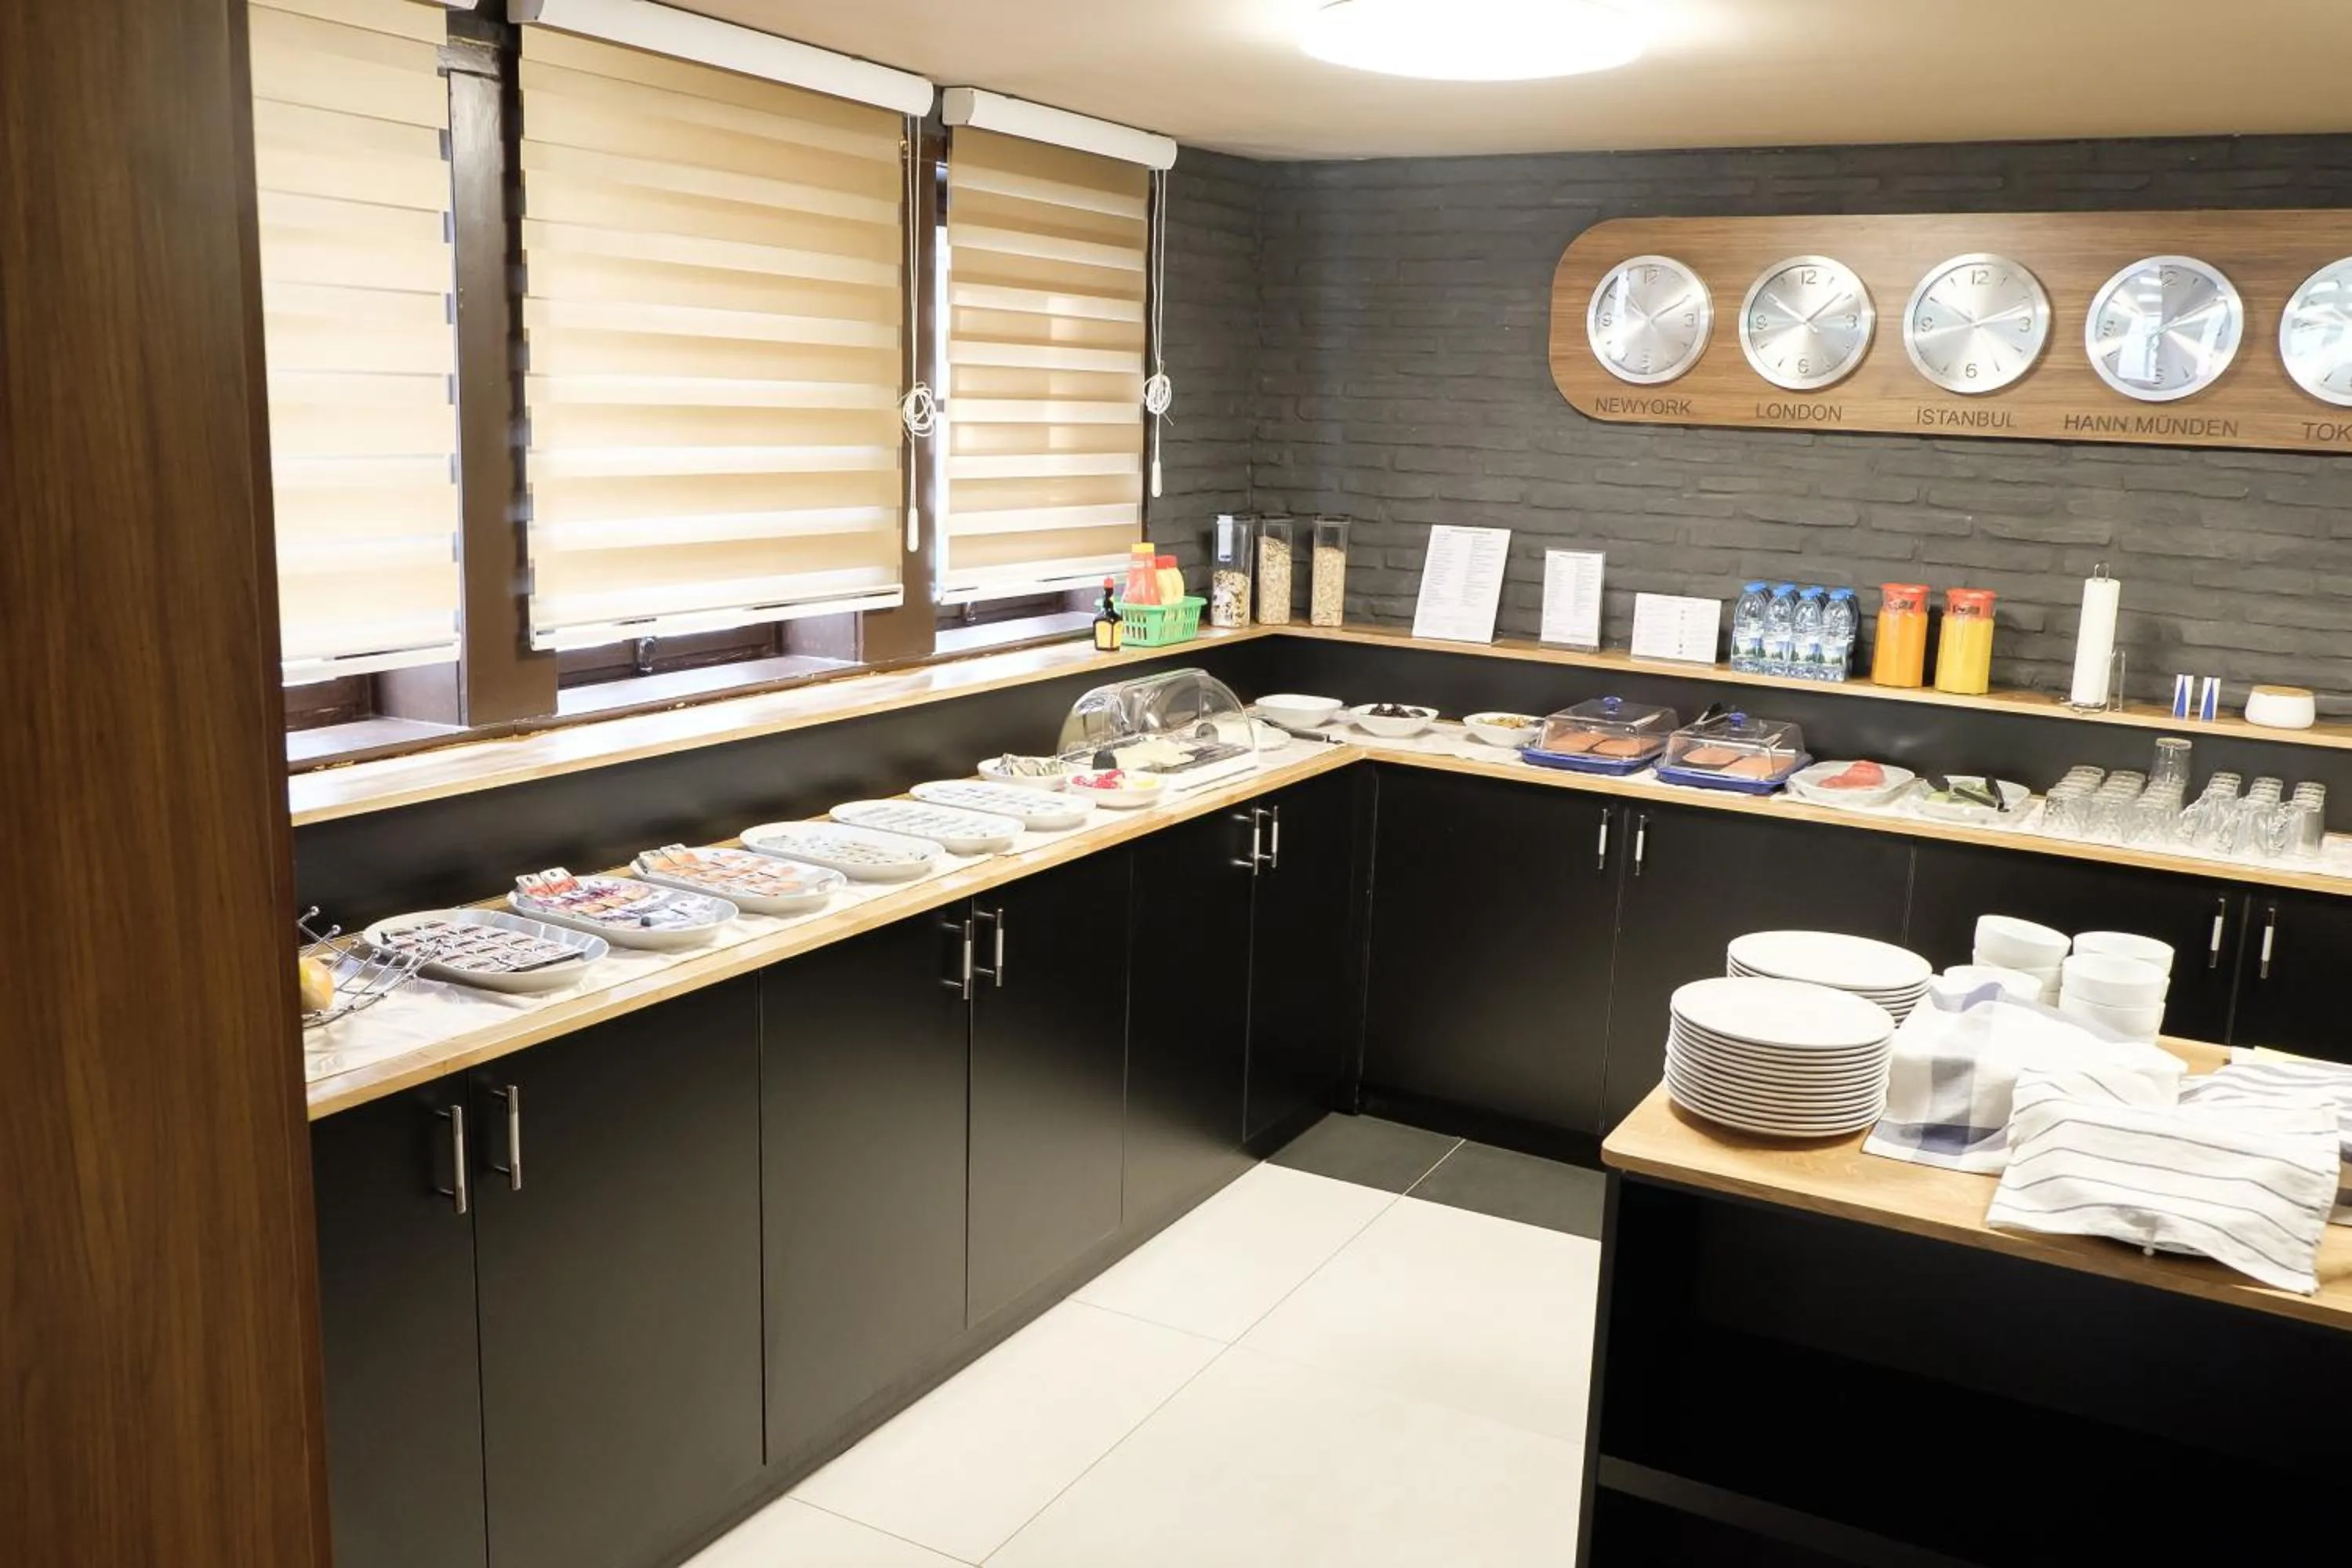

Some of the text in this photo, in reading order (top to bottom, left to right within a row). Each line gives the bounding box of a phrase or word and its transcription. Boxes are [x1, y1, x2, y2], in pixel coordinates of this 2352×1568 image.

[1801, 269, 1817, 285] 12
[1971, 270, 1990, 285] 12
[2019, 317, 2031, 333] 3
[1965, 363, 1978, 378] 6
[1595, 396, 1693, 416] NEWYORK
[1755, 401, 1842, 422] LONDON
[2301, 422, 2352, 442] TOK
